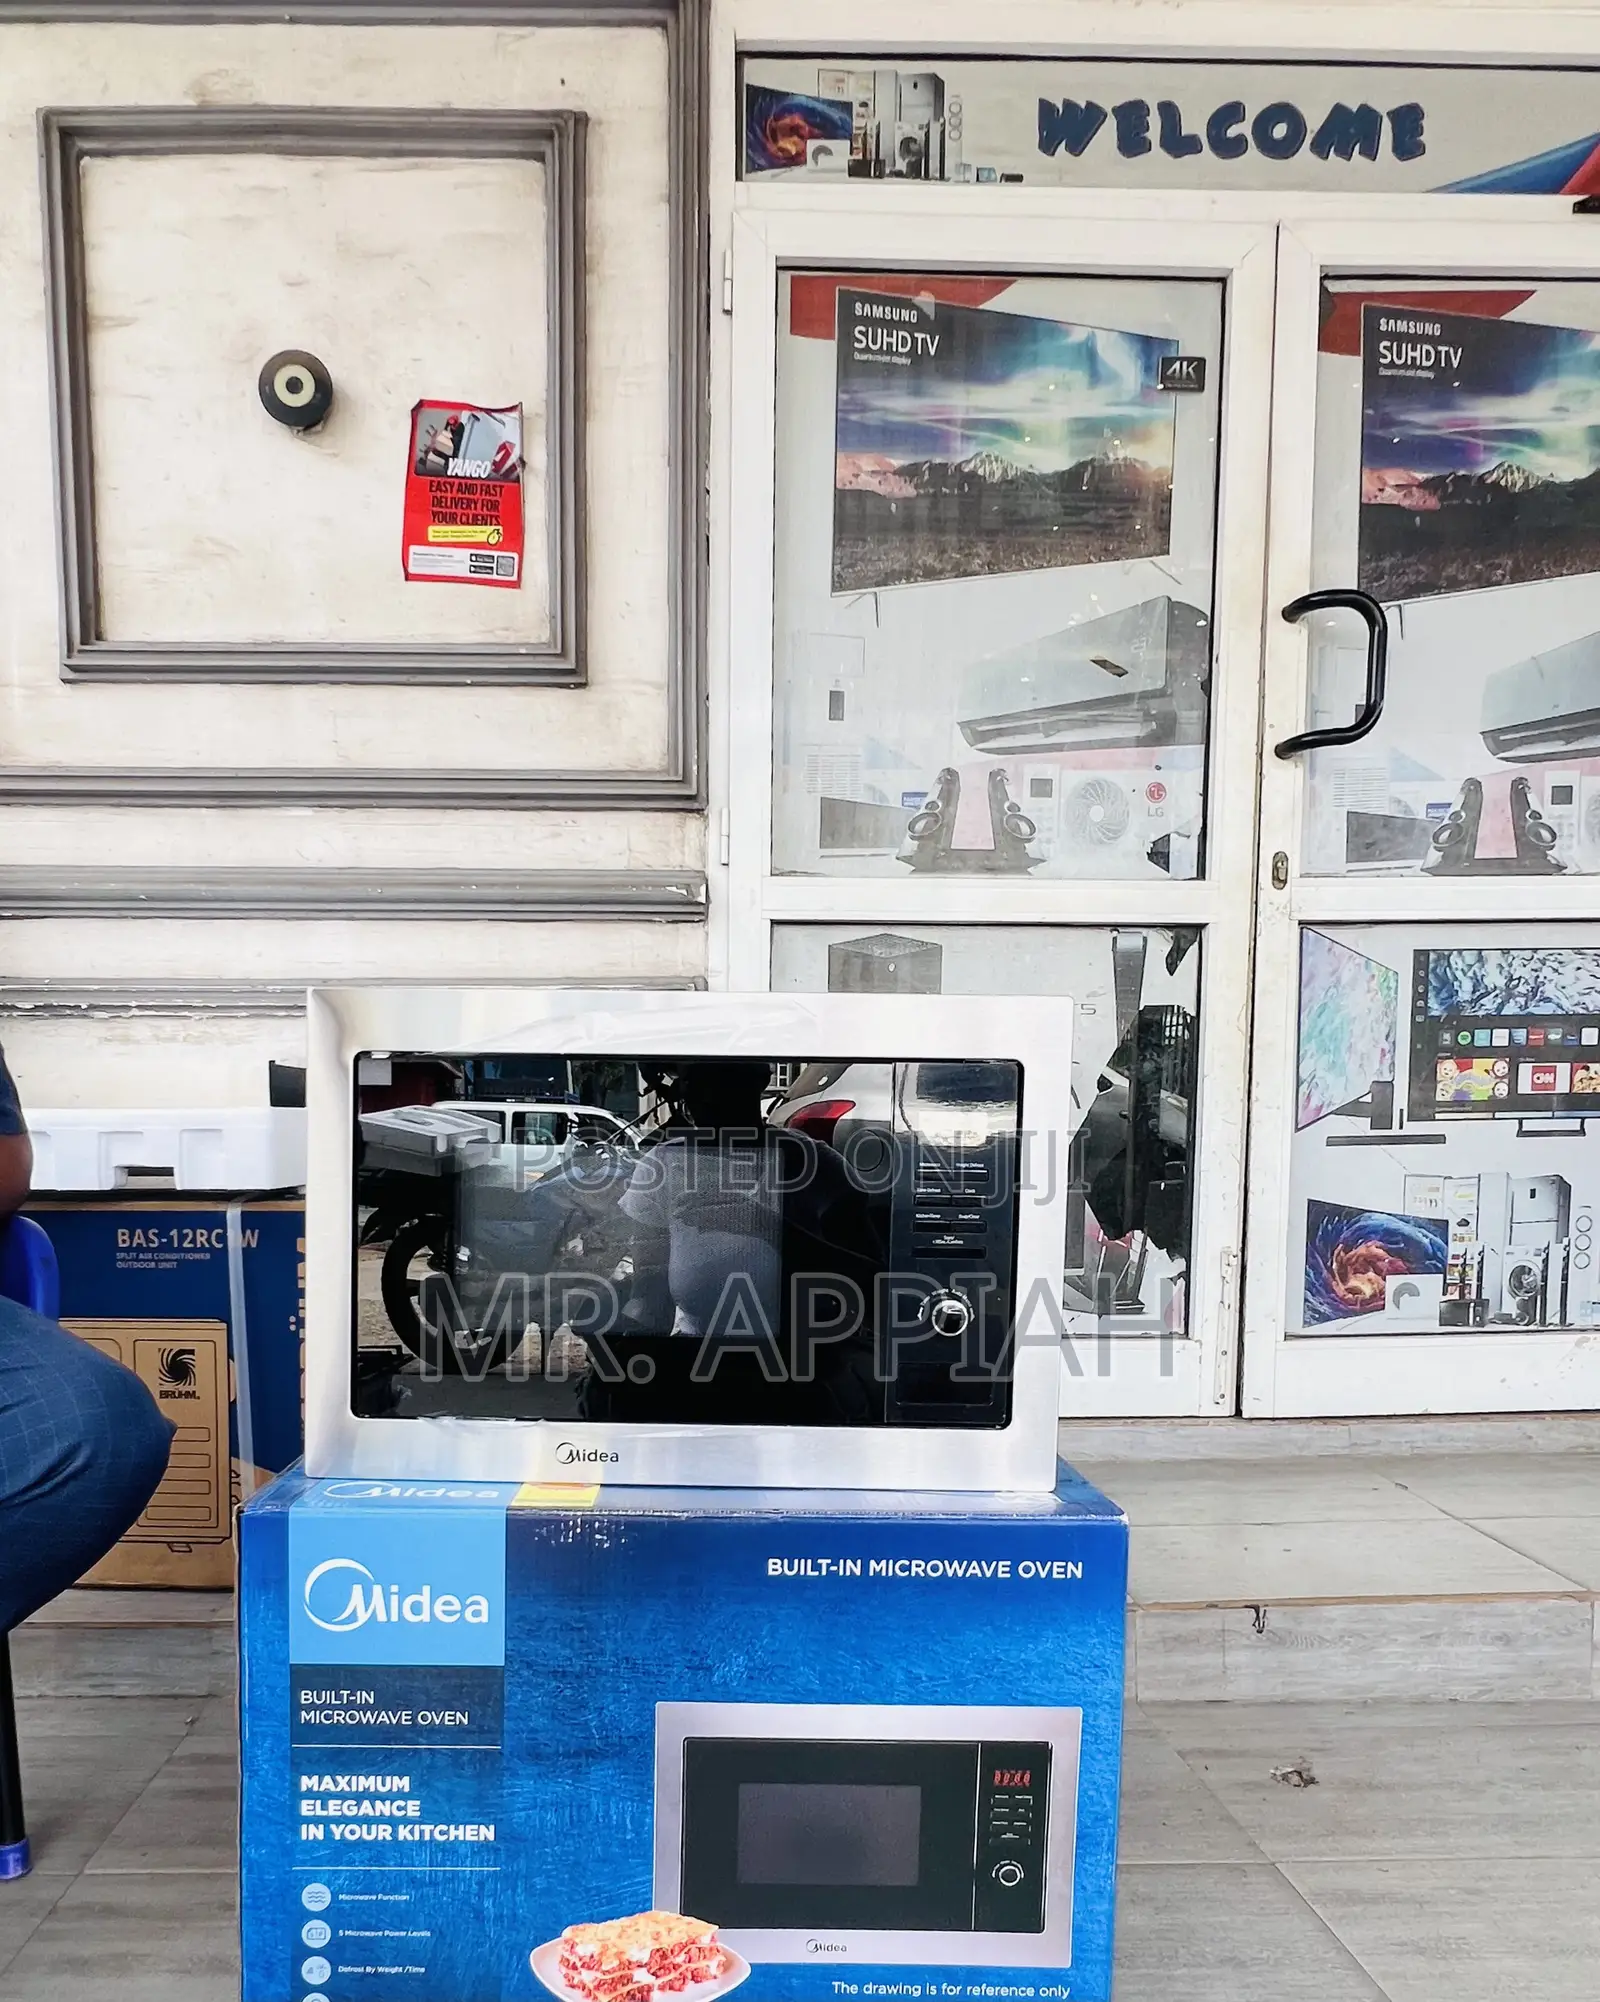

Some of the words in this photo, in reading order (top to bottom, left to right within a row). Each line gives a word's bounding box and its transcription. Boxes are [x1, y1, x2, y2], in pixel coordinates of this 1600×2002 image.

[1037, 97, 1427, 162] WELCOME
[854, 301, 918, 324] SAMSUNG
[1379, 317, 1441, 336] SAMSUNG
[1166, 360, 1198, 381] 4K
[446, 457, 492, 479] YANGO
[429, 480, 456, 495] EASY
[456, 481, 479, 497] AND
[479, 483, 505, 498] FAST
[431, 495, 479, 512] DELIVERY
[480, 499, 500, 514] FOR
[431, 511, 460, 526] YOUR
[1147, 806, 1164, 818] LG
[117, 1227, 260, 1248] BAS-12RCW
[116, 1252, 138, 1260] SPLIT
[138, 1252, 153, 1260] AIR
[153, 1252, 211, 1260] CONDITIONER
[116, 1261, 156, 1269] OUTDOOR
[158, 1261, 178, 1269] UNIT
[555, 1441, 619, 1465] Midea
[323, 1480, 500, 1500] Midea
[767, 1557, 862, 1577] BUILT-IN
[869, 1559, 1012, 1579] MICROWAVE
[1017, 1561, 1084, 1580] OVEN
[300, 1689, 376, 1705] BUILT-IN
[300, 1710, 413, 1726] MICROWAVE
[417, 1711, 470, 1727] OVEN
[300, 1774, 411, 1793] MAXIMUM
[300, 1799, 421, 1817] ELEGANCE
[300, 1824, 325, 1841] IN
[329, 1824, 393, 1841] YOUR
[398, 1824, 496, 1842] KITCHEN
[338, 1893, 377, 1901] Microwave
[377, 1893, 410, 1901] Function
[344, 1929, 384, 1937] Microwave
[806, 1938, 848, 1954] Midea
[338, 1965, 365, 1973] Defrost
[365, 1965, 377, 1975] By
[377, 1965, 403, 1974] Weight
[832, 1980, 859, 1995] The
[862, 1981, 921, 1999] drawing
[926, 1982, 938, 1996] is
[941, 1981, 963, 1996] for
[966, 1983, 1036, 1998] reference
[1039, 1983, 1071, 2001] only
